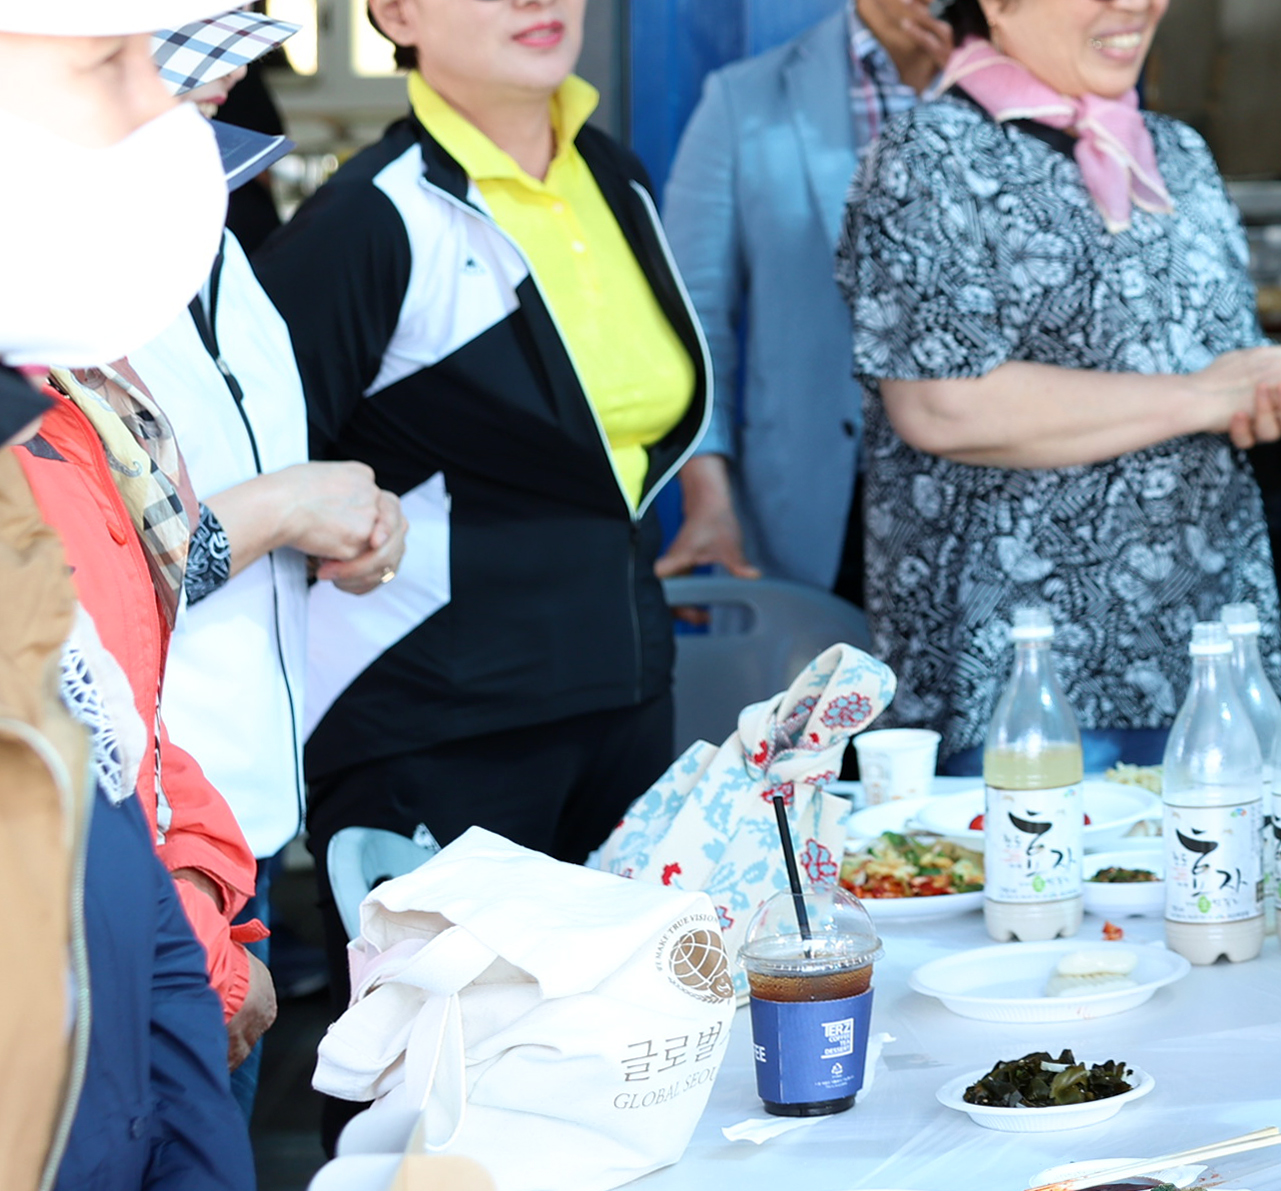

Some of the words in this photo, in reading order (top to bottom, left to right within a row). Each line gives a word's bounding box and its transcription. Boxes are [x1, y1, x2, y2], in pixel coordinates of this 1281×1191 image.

[654, 934, 671, 960] MAKE
[668, 916, 690, 936] TRUE
[613, 1081, 680, 1110] GLOBAL
